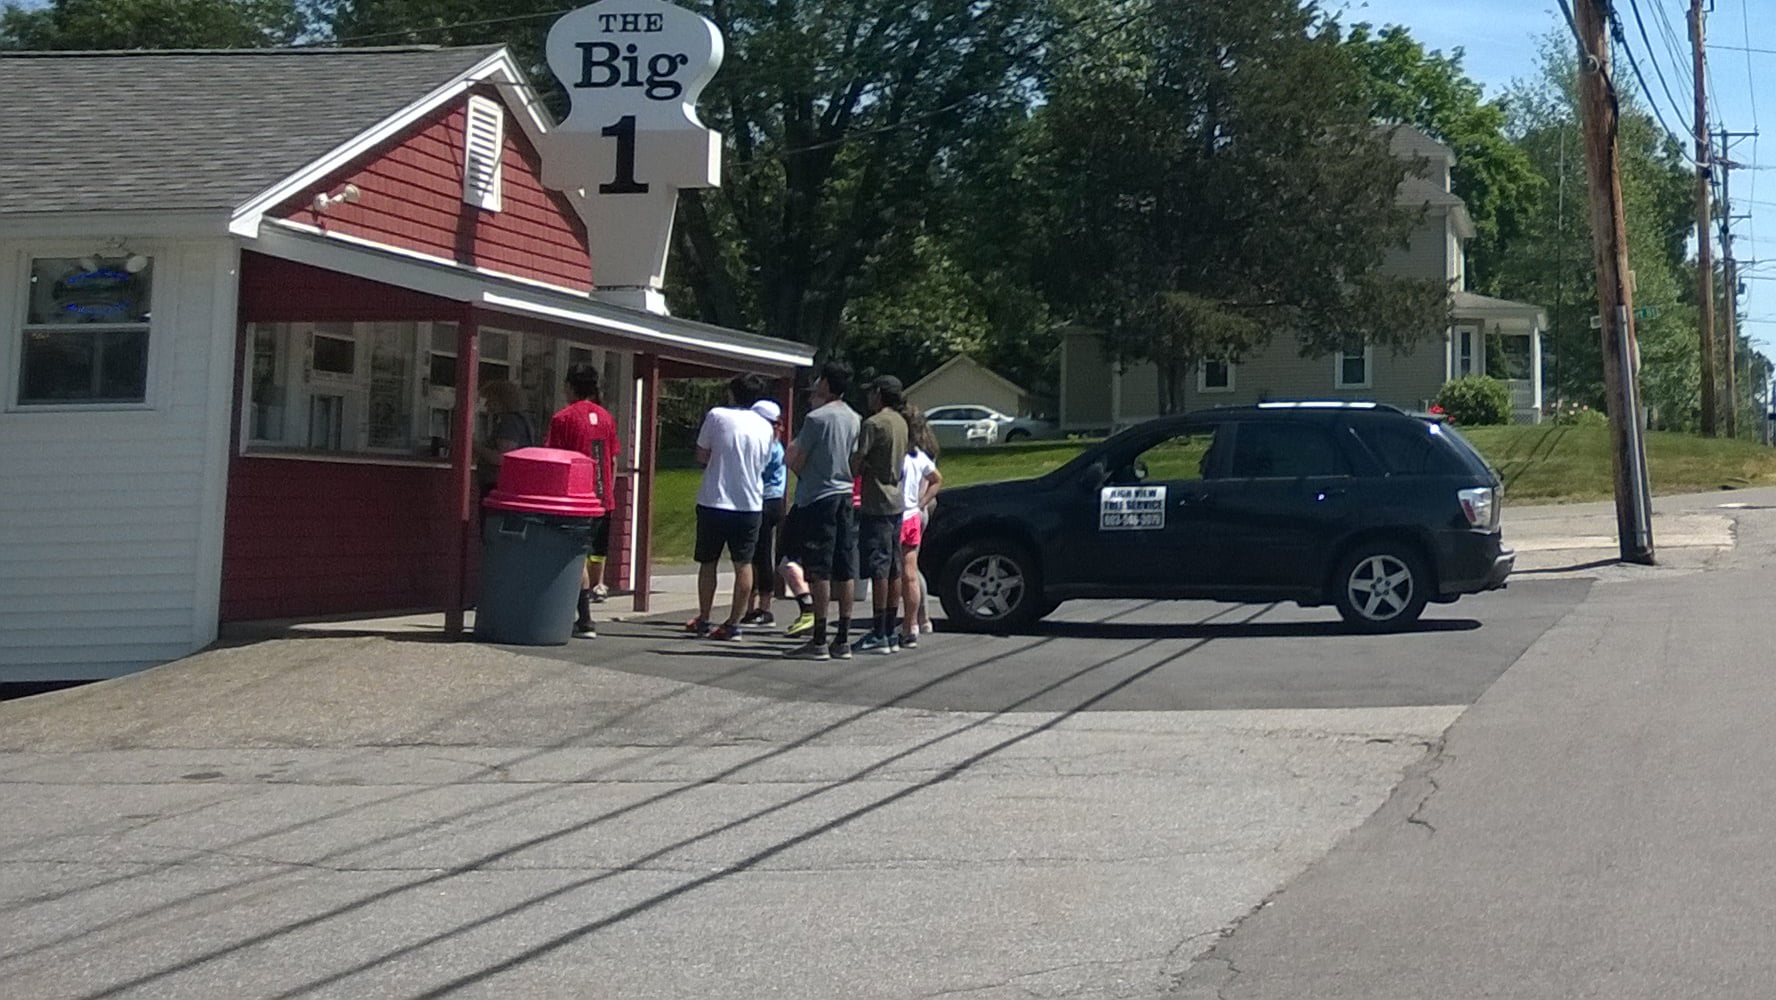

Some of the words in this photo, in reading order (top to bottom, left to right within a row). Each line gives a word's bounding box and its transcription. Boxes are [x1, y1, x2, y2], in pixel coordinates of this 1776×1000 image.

[599, 13, 664, 33] THE
[573, 41, 689, 101] Big
[600, 115, 650, 195] 1
